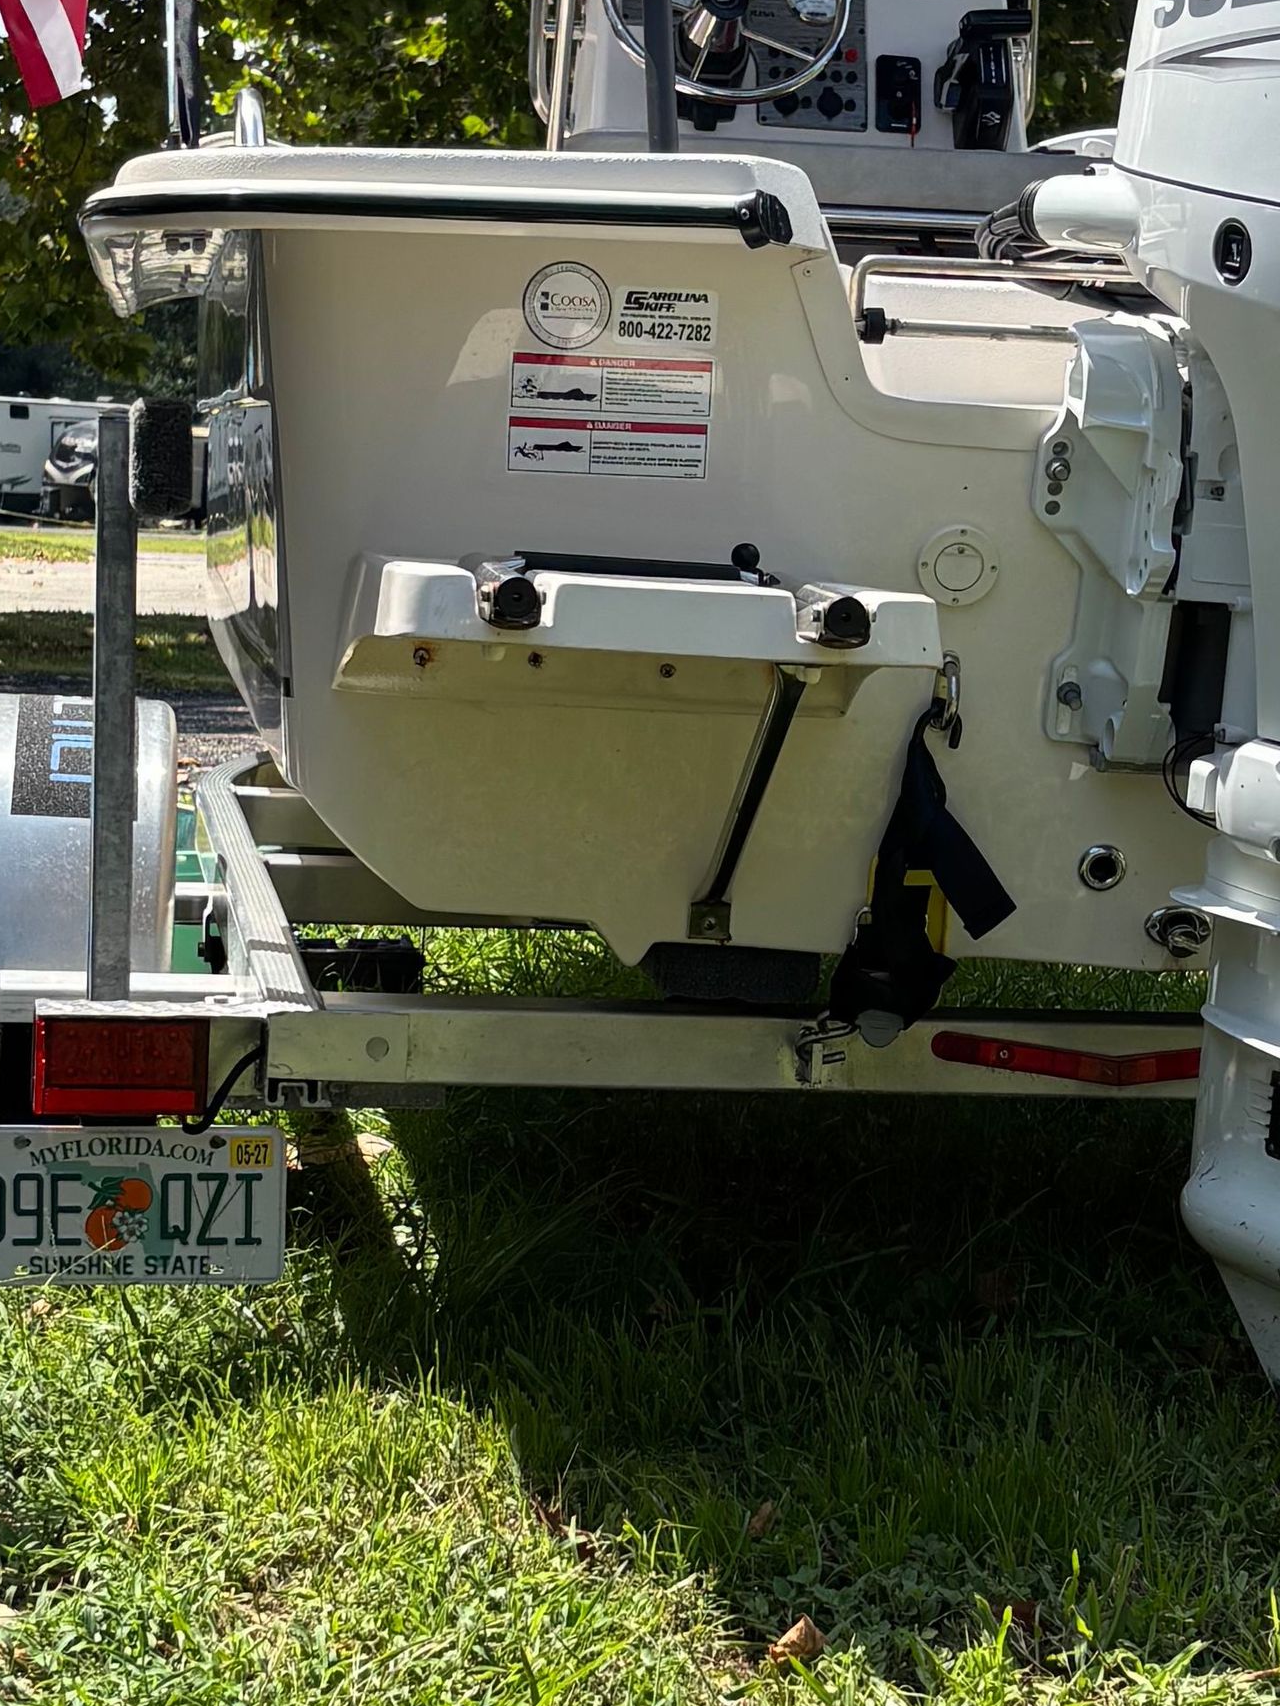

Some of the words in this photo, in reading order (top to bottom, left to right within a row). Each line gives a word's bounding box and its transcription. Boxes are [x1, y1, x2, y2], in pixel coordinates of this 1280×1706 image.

[619, 321, 712, 342] 800-422-7282
[598, 358, 636, 367] DANGER
[29, 1136, 215, 1167] MYFLORIDA.COM
[235, 1142, 269, 1166] 05-27
[29, 1254, 135, 1276] SUNSHINE
[144, 1254, 211, 1275] STATE
